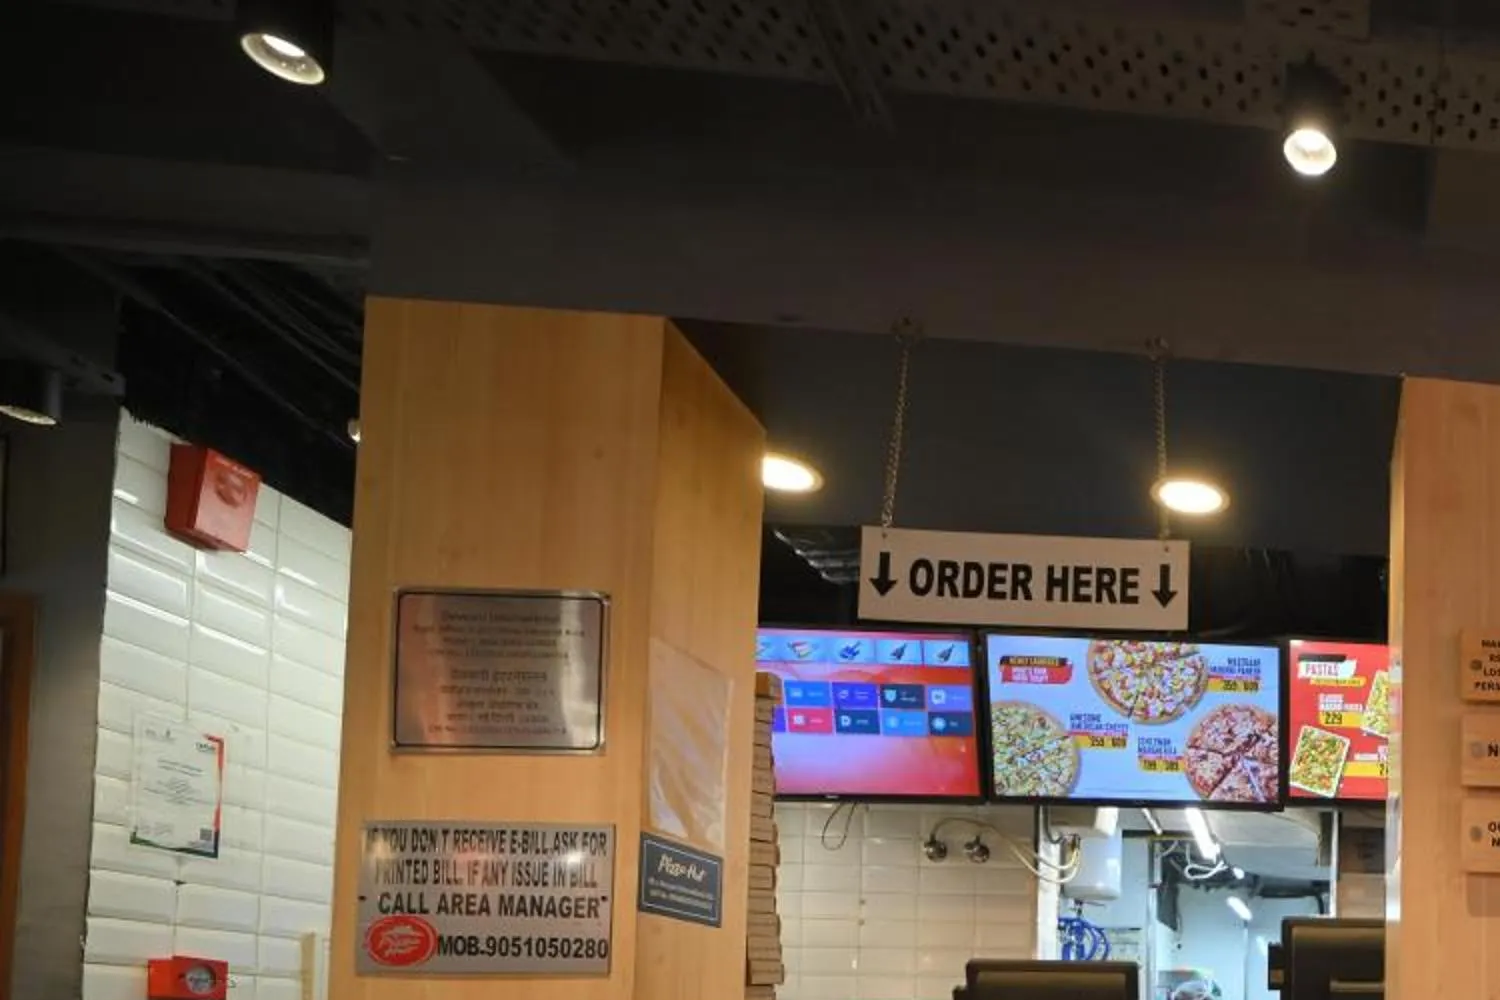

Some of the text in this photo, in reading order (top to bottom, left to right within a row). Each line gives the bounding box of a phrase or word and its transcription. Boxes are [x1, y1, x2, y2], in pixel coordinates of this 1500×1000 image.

[908, 558, 1140, 605] ORDER HERE
[453, 829, 506, 855] RECEIVE
[581, 831, 608, 857] FOR
[467, 860, 479, 887] IF
[481, 860, 509, 888] ANY
[511, 861, 549, 888] ISSUE
[552, 862, 566, 888] IN
[569, 862, 599, 889] BILL
[377, 891, 600, 919] CALL AREA MANAGER
